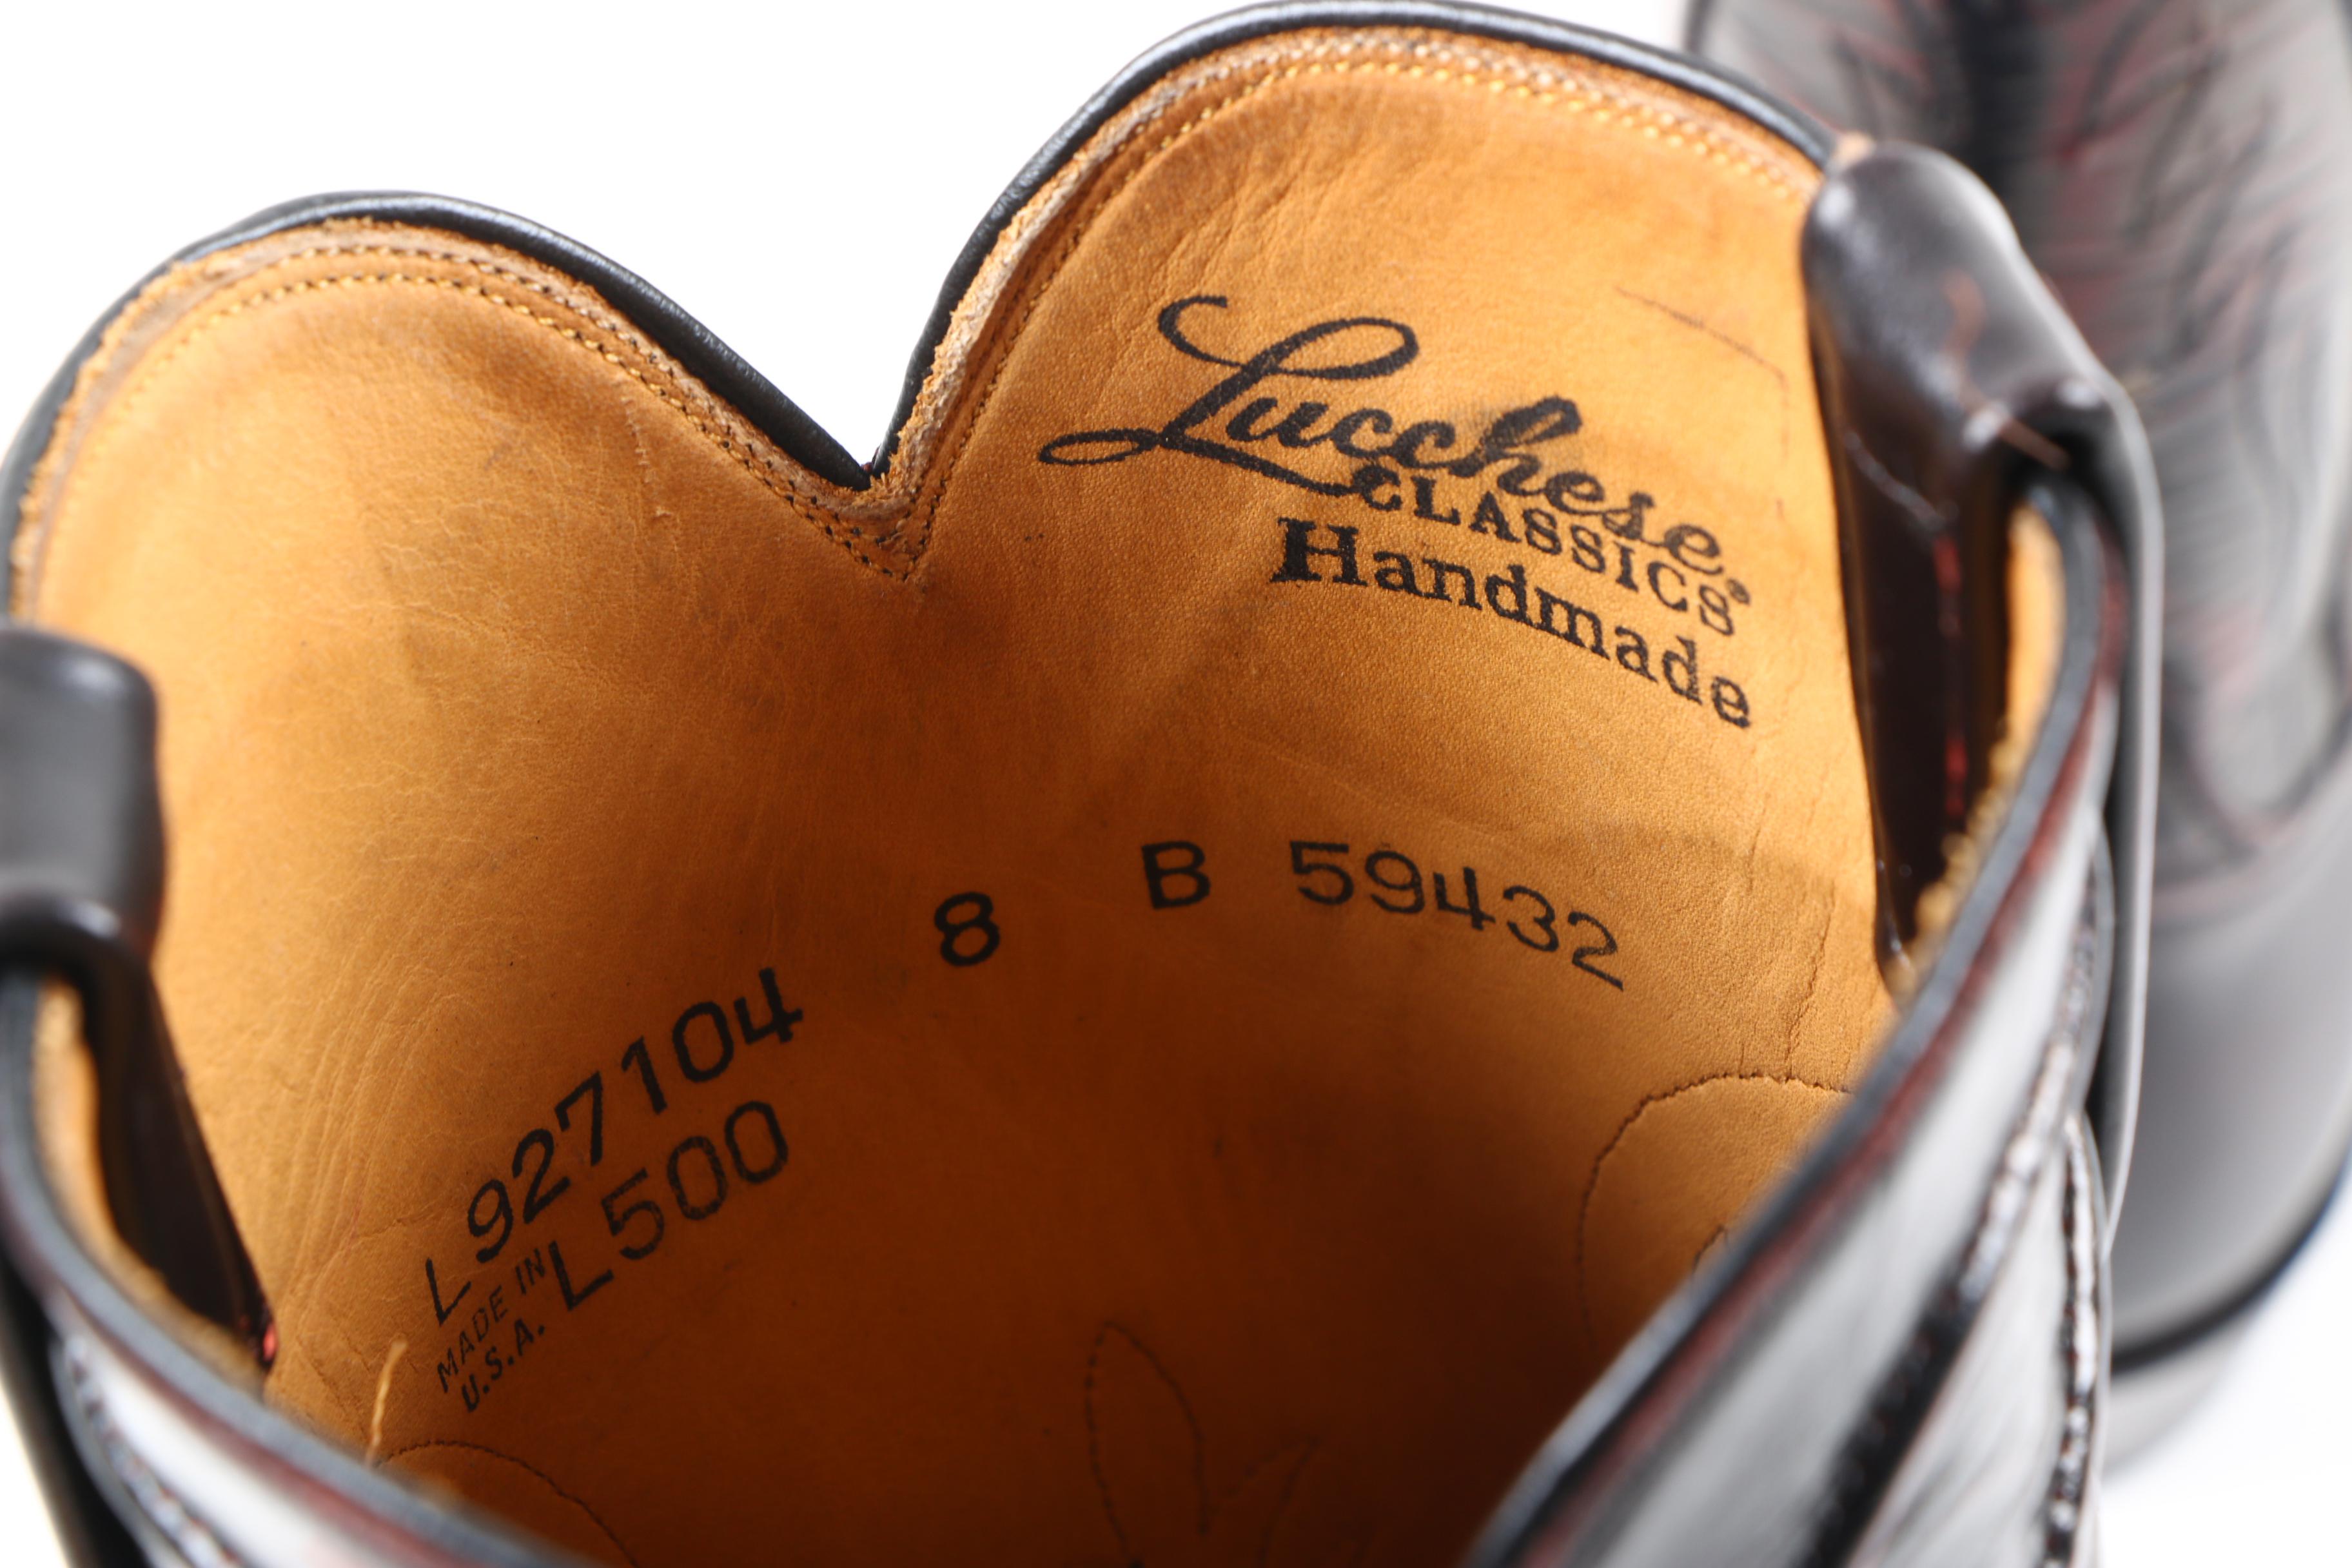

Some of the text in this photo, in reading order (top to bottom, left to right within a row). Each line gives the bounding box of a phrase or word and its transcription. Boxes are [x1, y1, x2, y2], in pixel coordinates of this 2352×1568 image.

[1039, 295, 1723, 576] Lucchese
[1270, 517, 1750, 729] Handmade
[934, 840, 1623, 991] 8 B 59432
[549, 1101, 789, 1311] L500
[437, 1248, 545, 1393] MADE IN
[462, 1319, 545, 1413] U.S.A.
